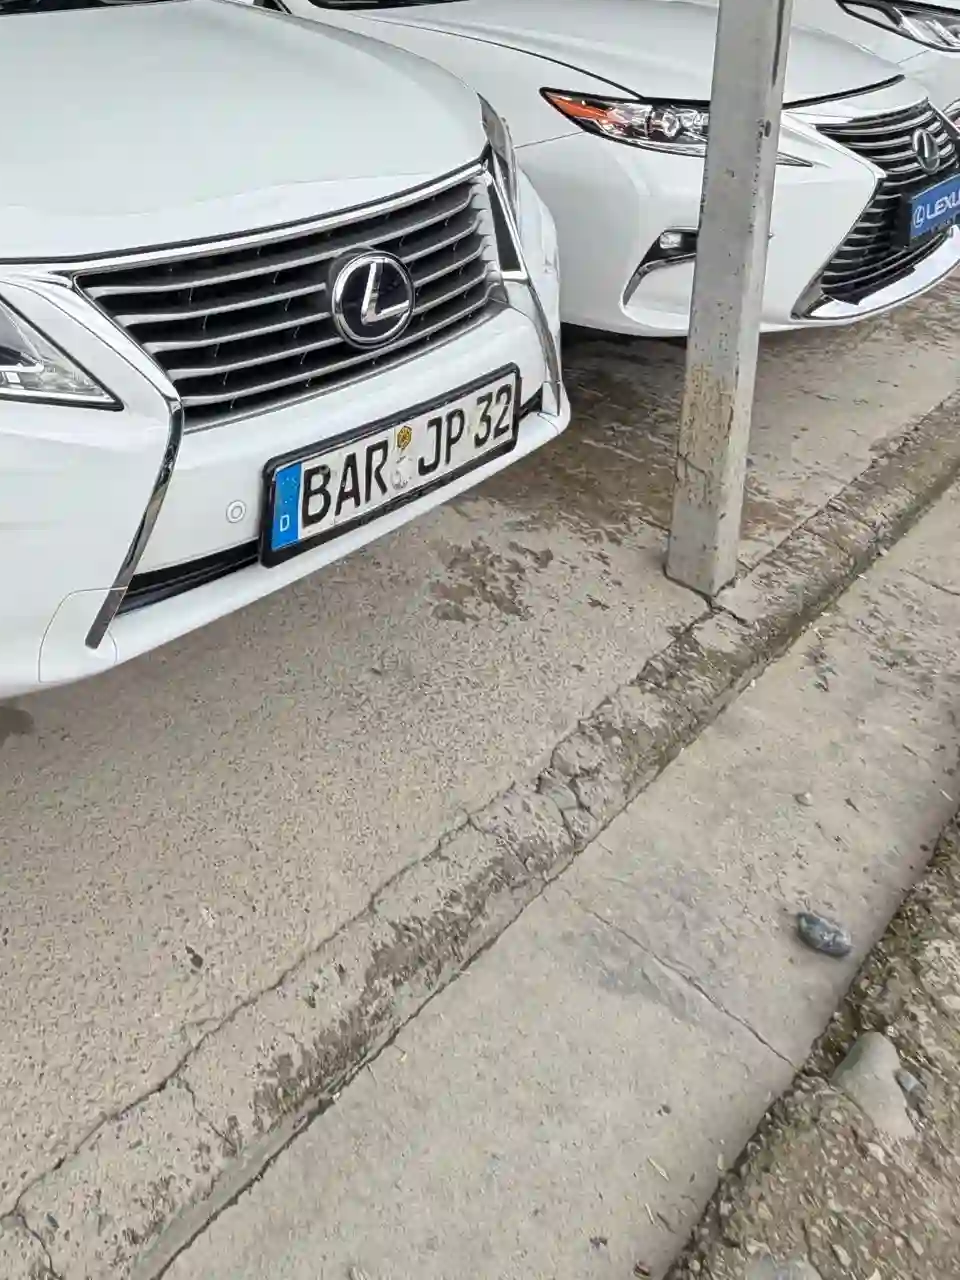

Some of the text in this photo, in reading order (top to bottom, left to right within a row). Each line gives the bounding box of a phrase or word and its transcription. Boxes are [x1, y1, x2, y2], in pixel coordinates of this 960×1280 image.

[301, 439, 389, 529] BAR
[474, 383, 513, 449] 32
[279, 514, 290, 533] D
